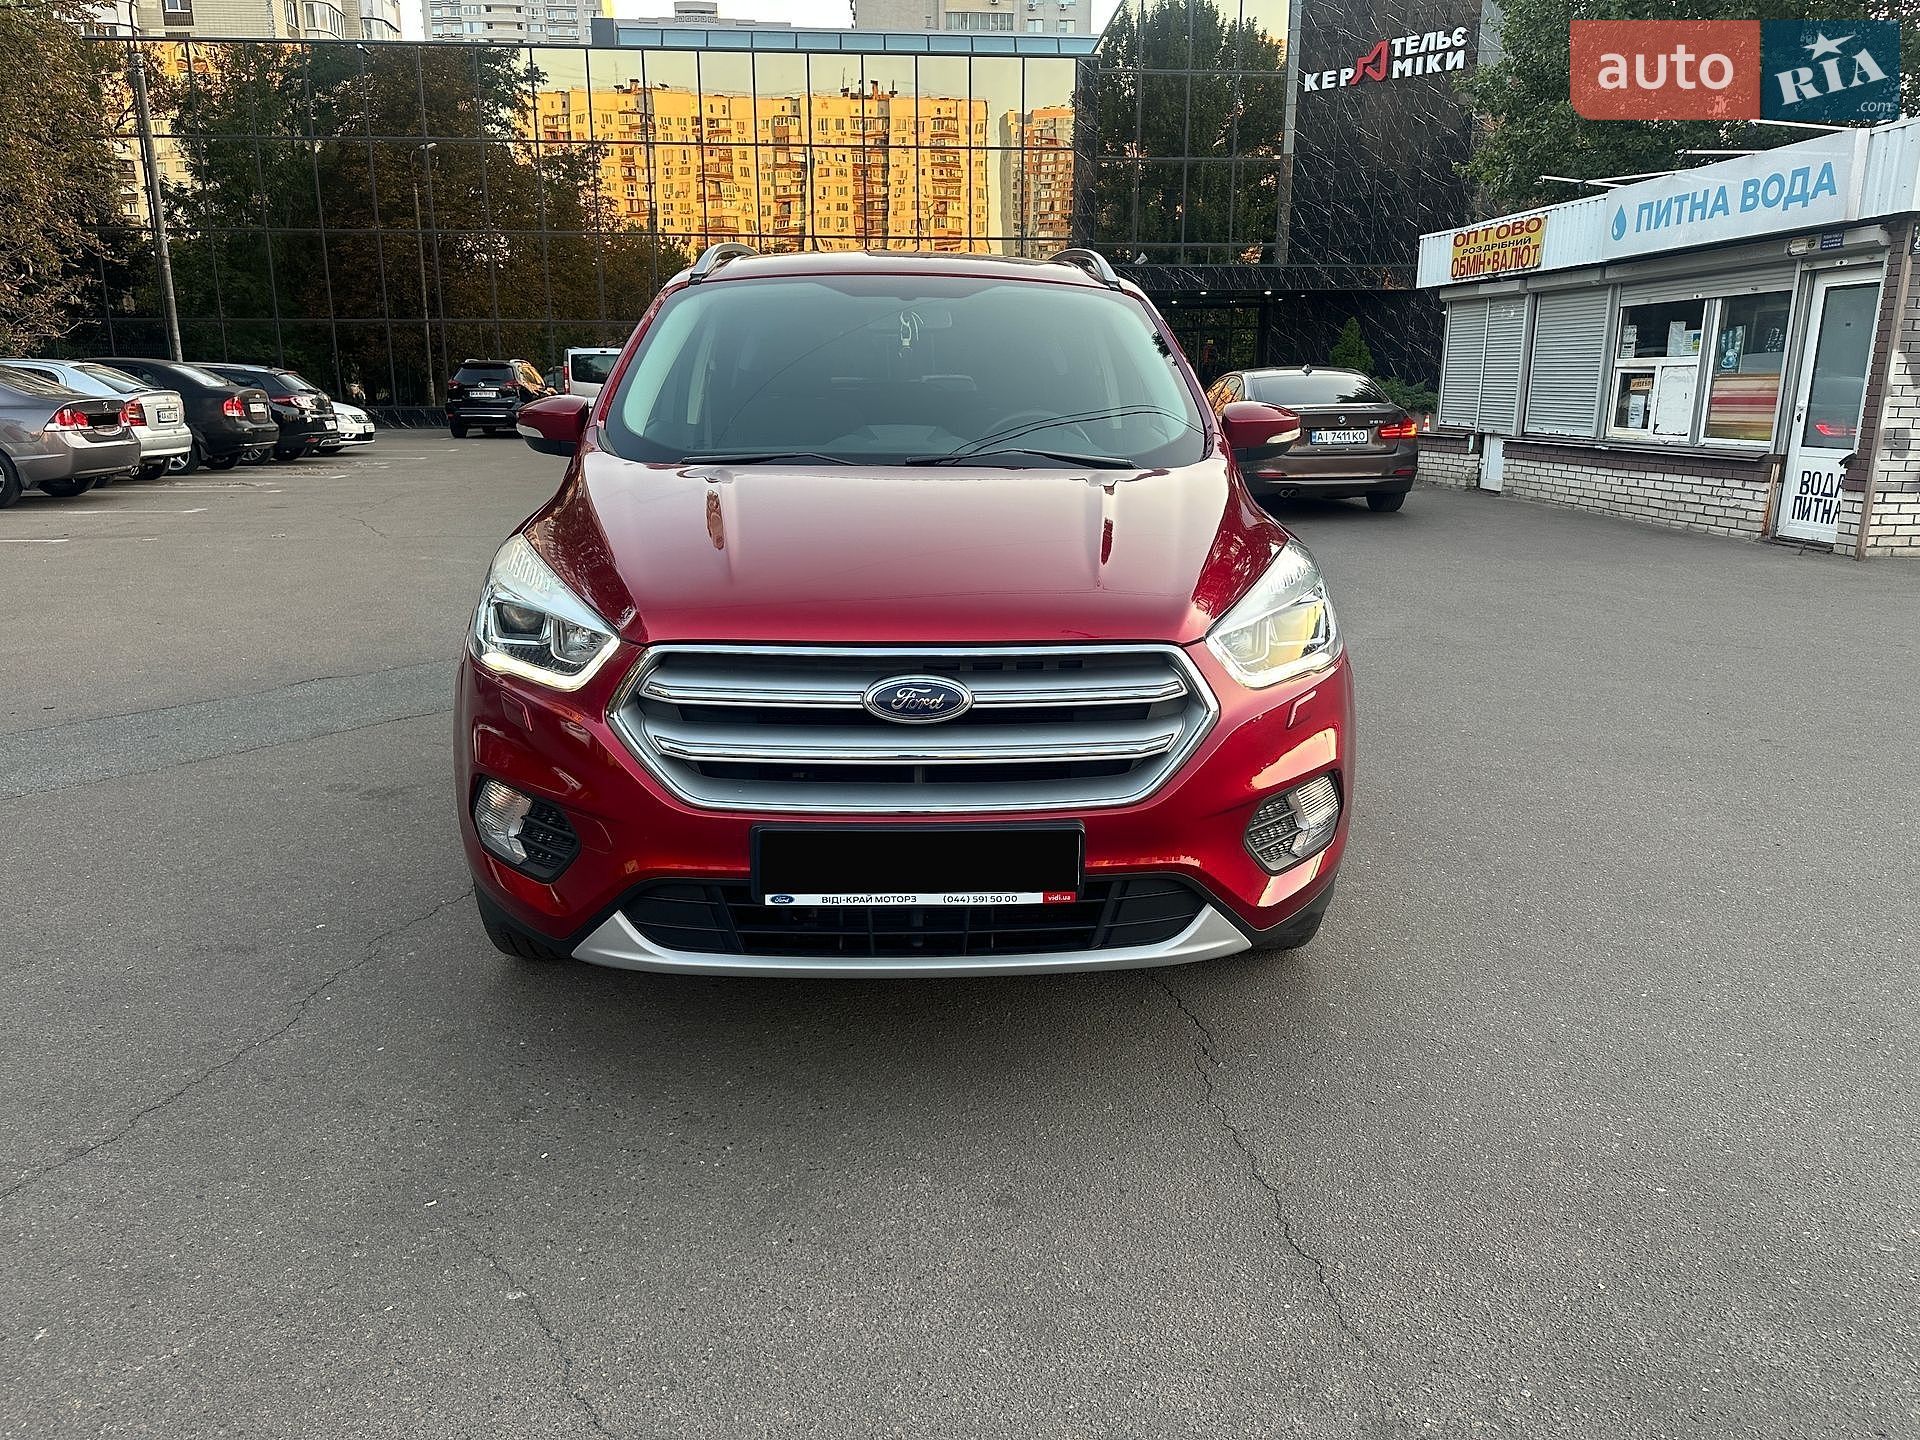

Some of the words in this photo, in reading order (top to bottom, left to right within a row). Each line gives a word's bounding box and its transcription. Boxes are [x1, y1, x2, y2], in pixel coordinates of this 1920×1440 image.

[1635, 185, 1730, 233] ПИТНА
[1740, 161, 1837, 213] ВОДА
[1453, 217, 1543, 248] ОПТОВО
[1462, 235, 1532, 256] РОЗДРІБНИЙ
[1791, 496, 1841, 524] ПИТНА
[891, 687, 945, 710] Ford
[821, 894, 873, 904] ВІДІ-КРАЙ
[943, 895, 970, 904] (044)
[990, 895, 1003, 903] 50
[1004, 895, 1018, 903] 00
[1047, 893, 1071, 901] vidi.ua
